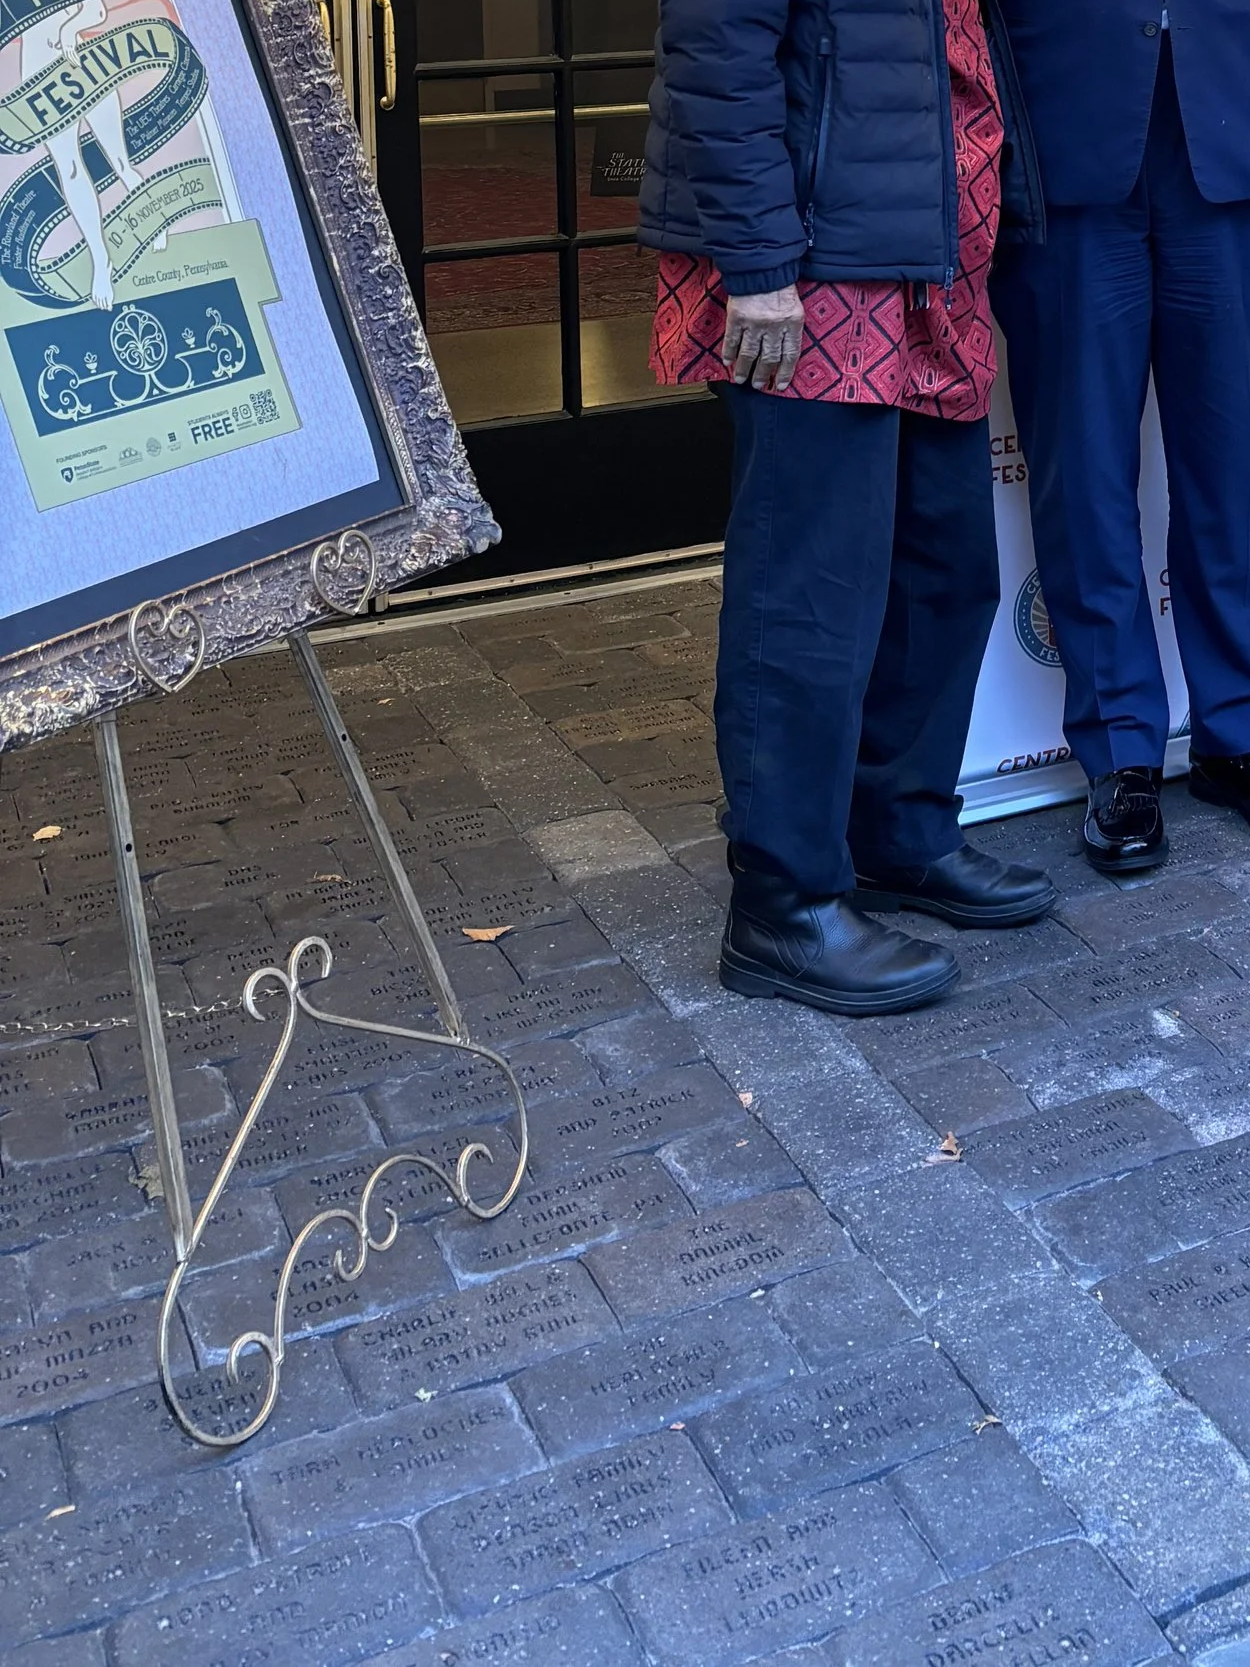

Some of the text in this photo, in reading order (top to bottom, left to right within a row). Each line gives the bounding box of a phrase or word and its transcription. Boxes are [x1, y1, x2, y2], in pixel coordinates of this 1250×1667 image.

[29, 31, 171, 127] FESTIVAL
[604, 168, 646, 176] THEATR
[17, 189, 37, 216] Theatre
[108, 177, 206, 250] 10 16 NOVEMBER 2025
[131, 259, 230, 288] Centre County, Pennsylvania
[191, 416, 235, 445] FREE
[996, 746, 1070, 775] CENTR
[556, 1088, 696, 1137] AND PATRICK
[591, 1088, 641, 1109] BETZ
[686, 1219, 731, 1240] THE
[680, 1244, 787, 1289] KINGDOM
[88, 1311, 139, 1335] AND
[44, 1334, 136, 1368] MAZZA
[16, 1370, 91, 1394] 2004
